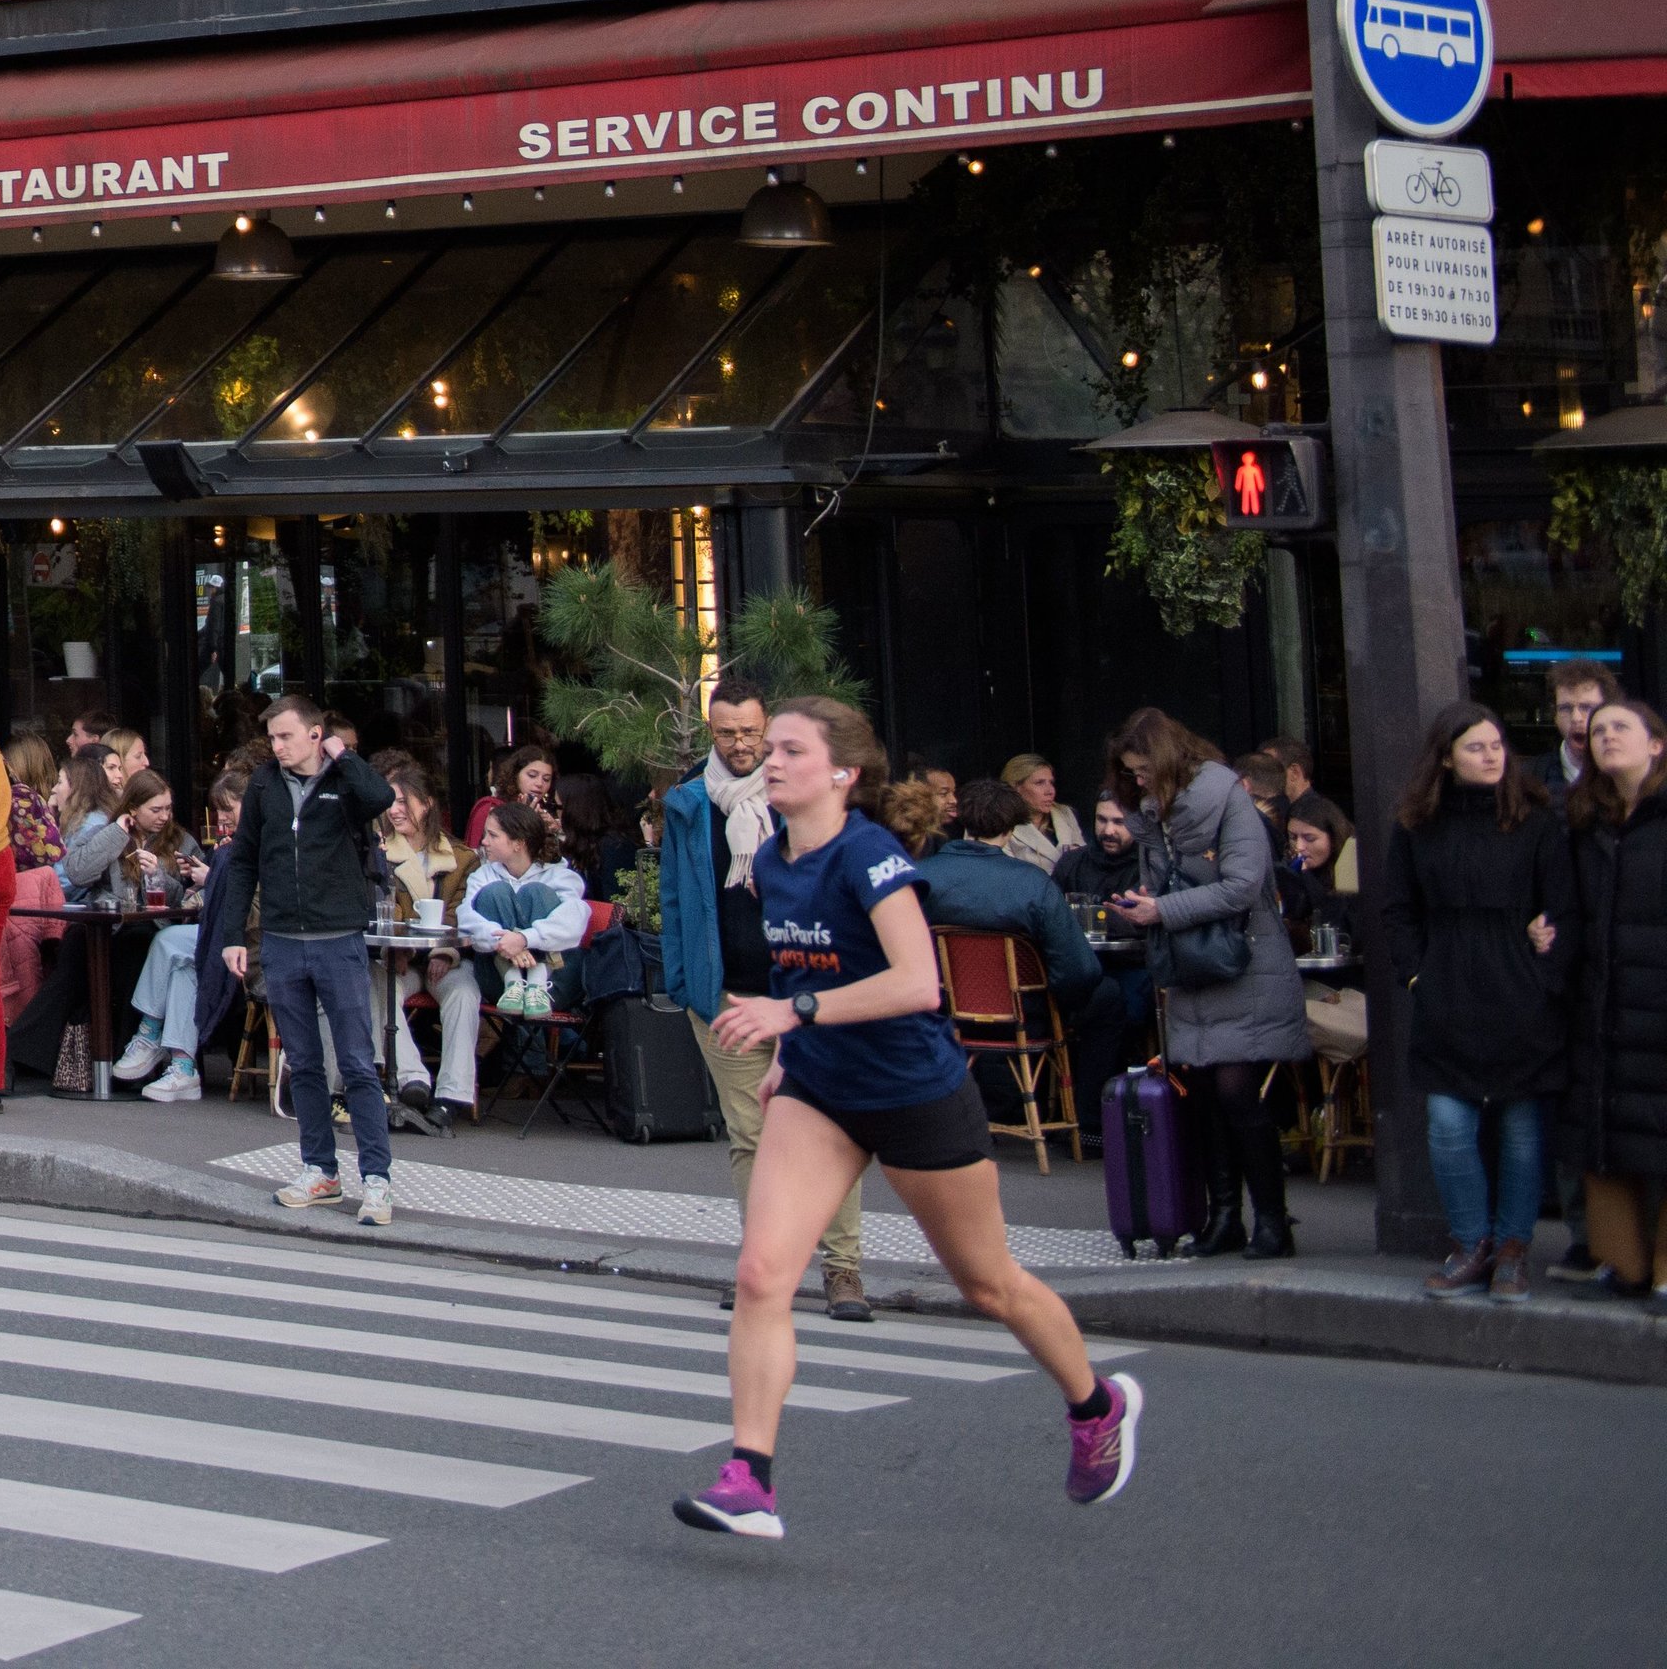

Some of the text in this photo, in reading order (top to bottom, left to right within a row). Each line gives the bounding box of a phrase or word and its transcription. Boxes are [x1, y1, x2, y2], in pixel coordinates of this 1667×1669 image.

[516, 67, 1105, 160] SERVICE CONTINU
[1387, 231, 1486, 254] ARRÊT AUTORISÉ
[1388, 255, 1487, 279] POUR LIVRAISON
[1388, 280, 1403, 293] DE
[1408, 282, 1445, 298] 19h30
[1460, 288, 1490, 303] 7h30
[1389, 305, 1492, 328] ET DE 9h30 à 16h30
